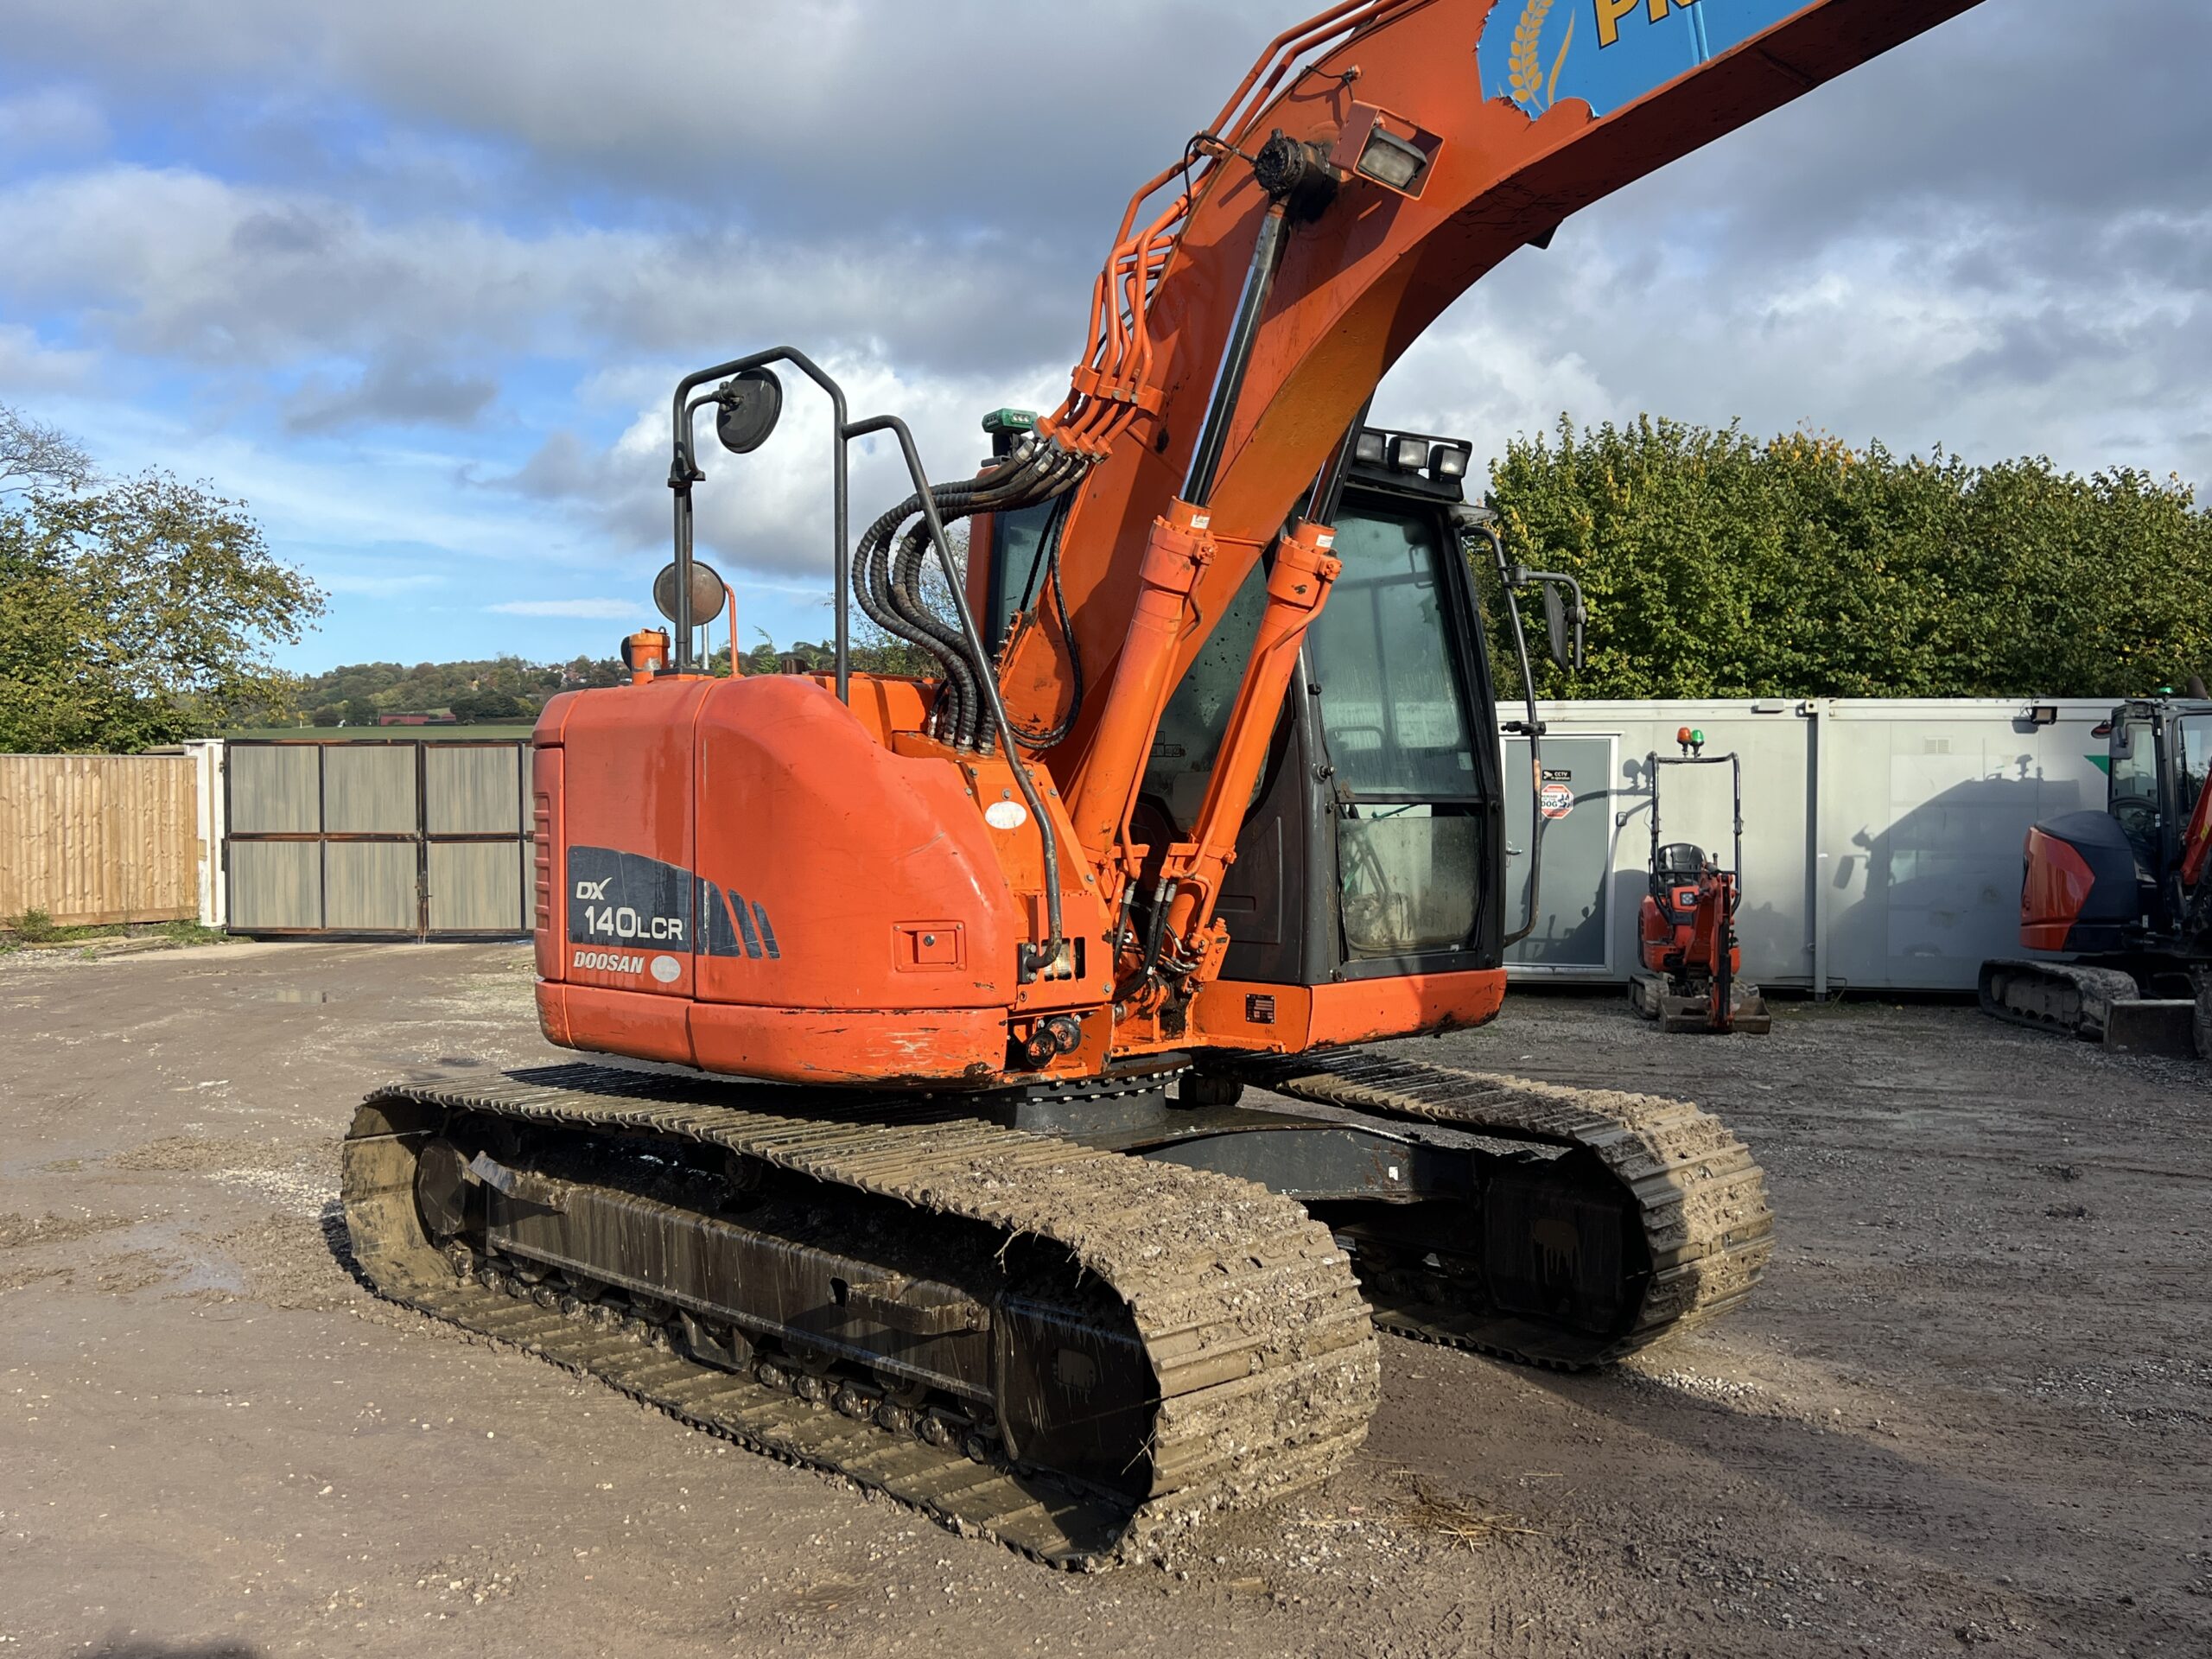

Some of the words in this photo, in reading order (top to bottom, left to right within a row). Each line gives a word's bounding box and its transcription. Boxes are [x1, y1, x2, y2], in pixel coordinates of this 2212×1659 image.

[576, 877, 613, 900] DX
[585, 906, 683, 940] 140LCR
[573, 951, 645, 974] DOOSAN
